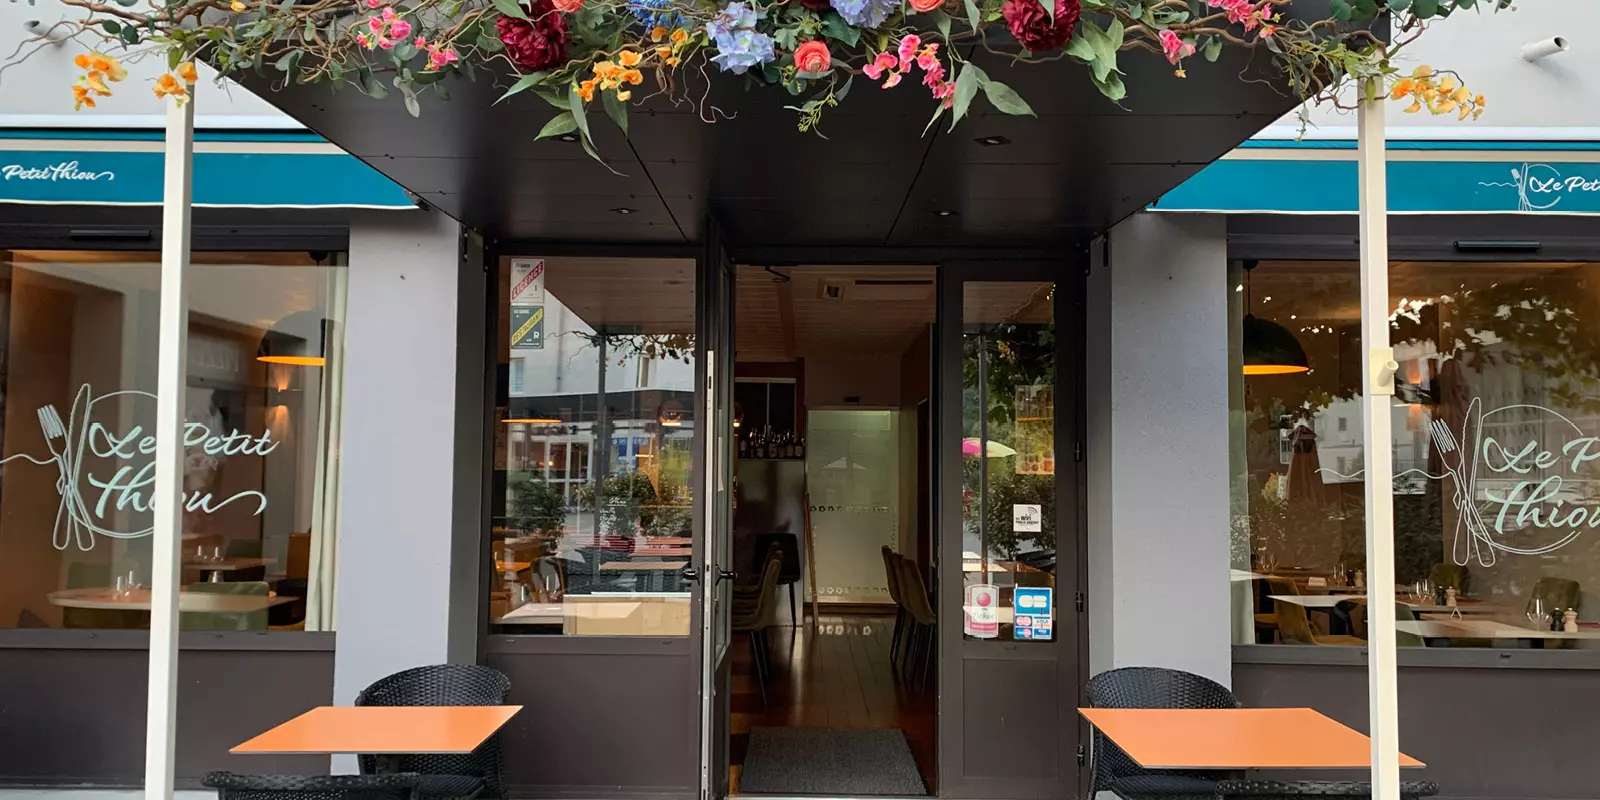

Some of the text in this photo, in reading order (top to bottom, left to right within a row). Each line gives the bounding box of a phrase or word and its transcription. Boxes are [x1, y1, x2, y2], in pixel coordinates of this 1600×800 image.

[49, 161, 115, 181] Thiou
[1529, 176, 1564, 193] Le
[512, 263, 543, 298] LICENCE
[533, 331, 540, 339] R
[89, 422, 157, 459] Le
[1483, 436, 1560, 473] Le
[88, 460, 267, 519] Thu
